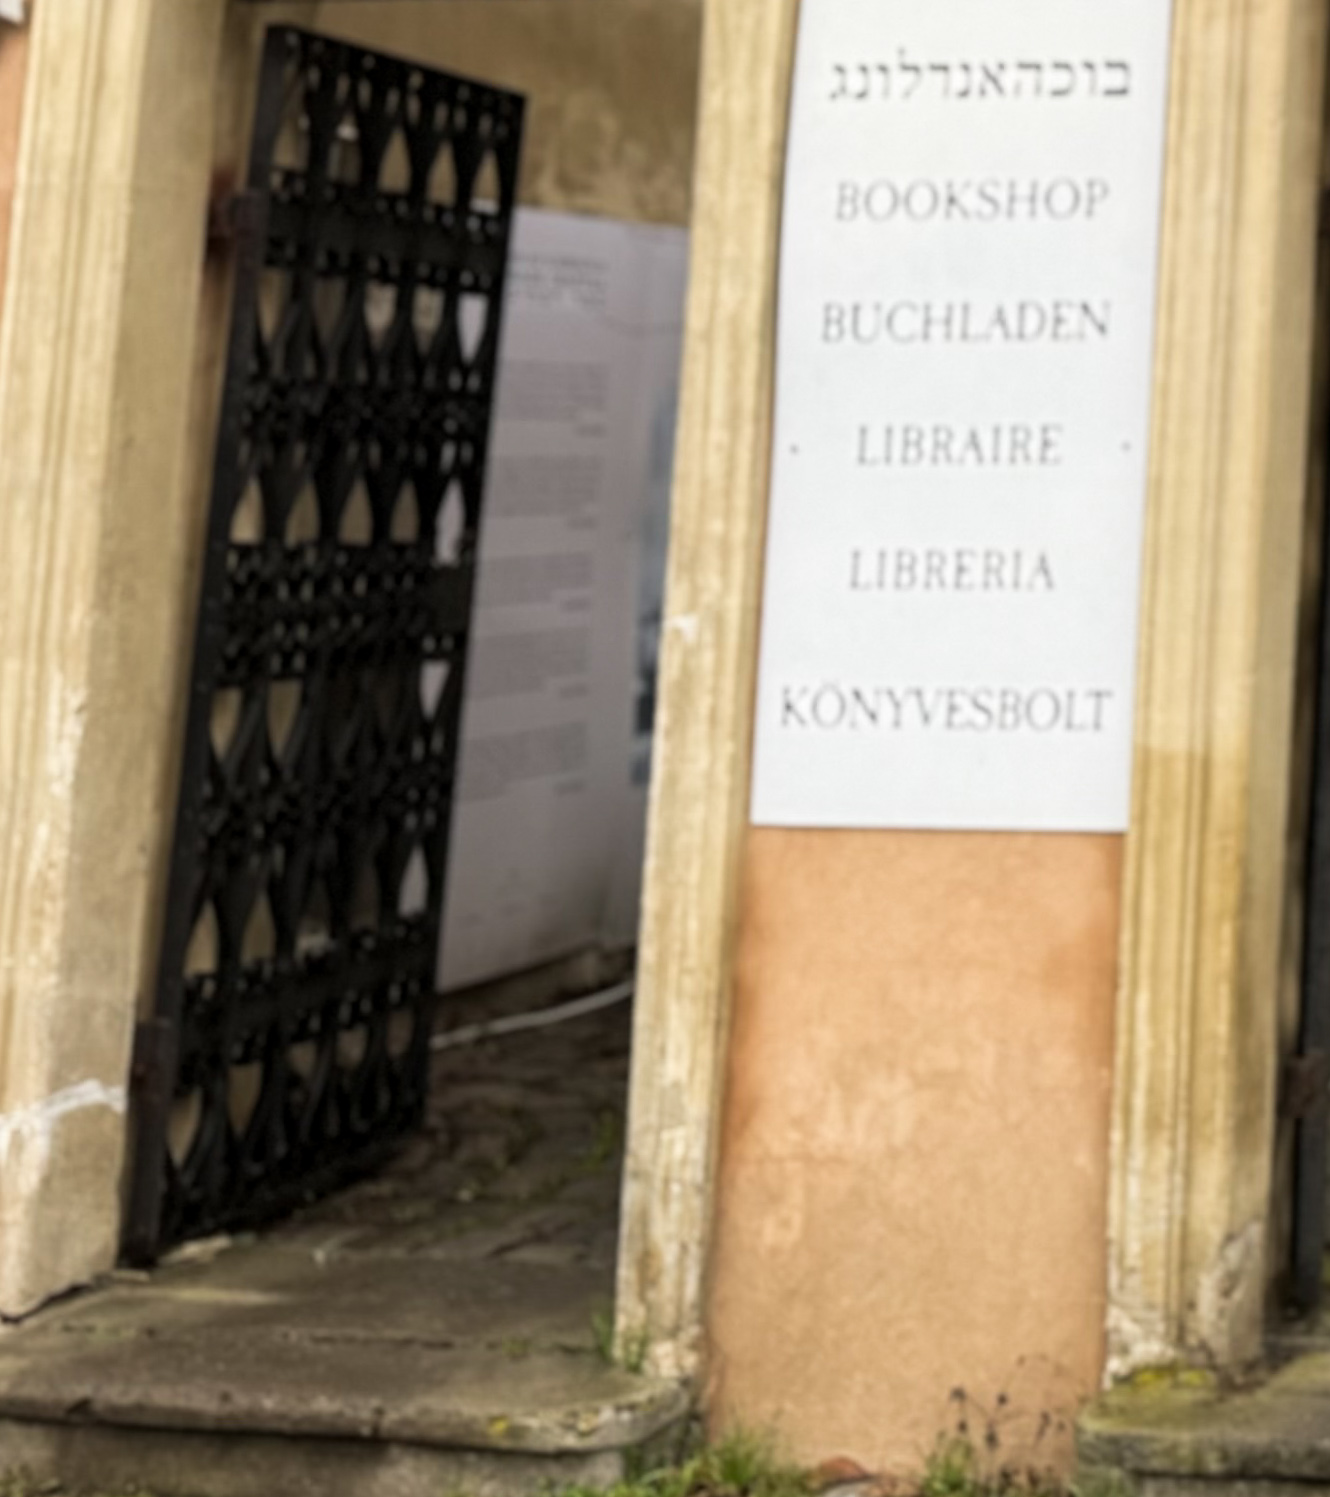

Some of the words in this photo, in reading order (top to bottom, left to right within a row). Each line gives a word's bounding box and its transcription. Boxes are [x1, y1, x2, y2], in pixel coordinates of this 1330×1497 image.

[836, 178, 1110, 221] BOOKSHOP
[822, 300, 1110, 344] BUCHLADEN
[857, 424, 1062, 466] LIBRAIRE
[849, 548, 1055, 591] LIBRERIA
[781, 681, 1113, 731] KÖNYVESBOLT
